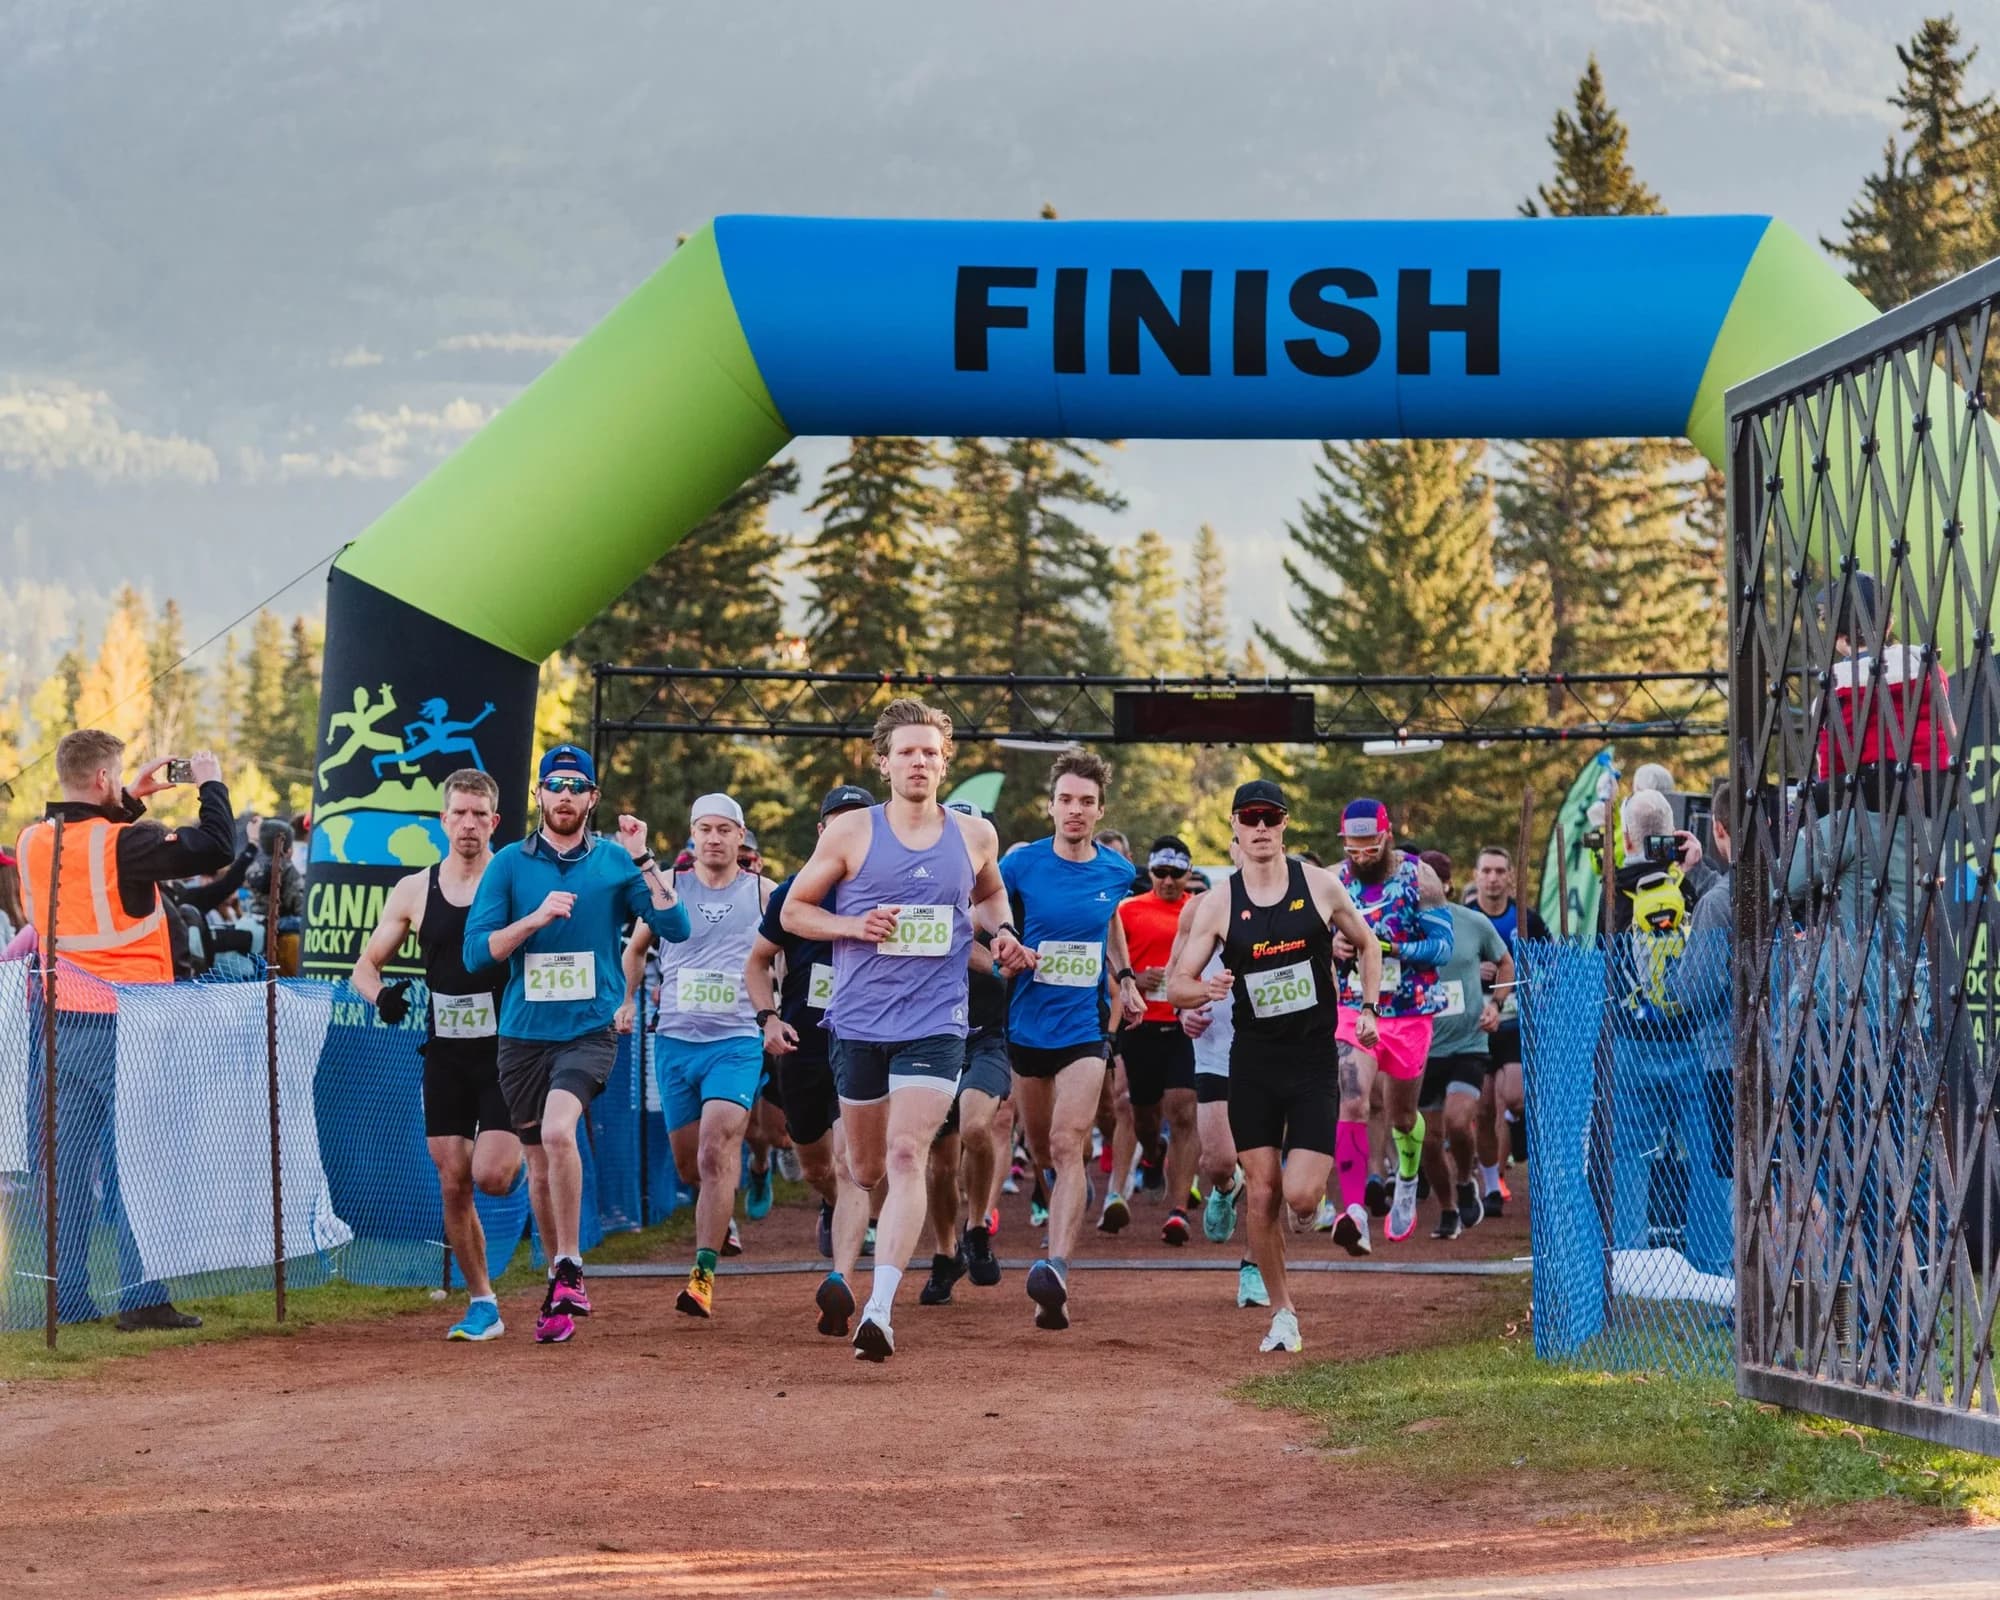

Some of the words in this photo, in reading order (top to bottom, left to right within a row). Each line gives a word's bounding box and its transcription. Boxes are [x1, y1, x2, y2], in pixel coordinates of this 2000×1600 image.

[954, 266, 1501, 377] FINISH
[307, 883, 397, 929] CANM
[304, 929, 355, 955] ROCKY
[1252, 939, 1306, 960] Horizon
[1040, 955, 1097, 977] 2669
[530, 967, 587, 990] 2161
[681, 983, 735, 1003] 2506
[1254, 978, 1311, 1007] 2260
[438, 1008, 489, 1027] 2747
